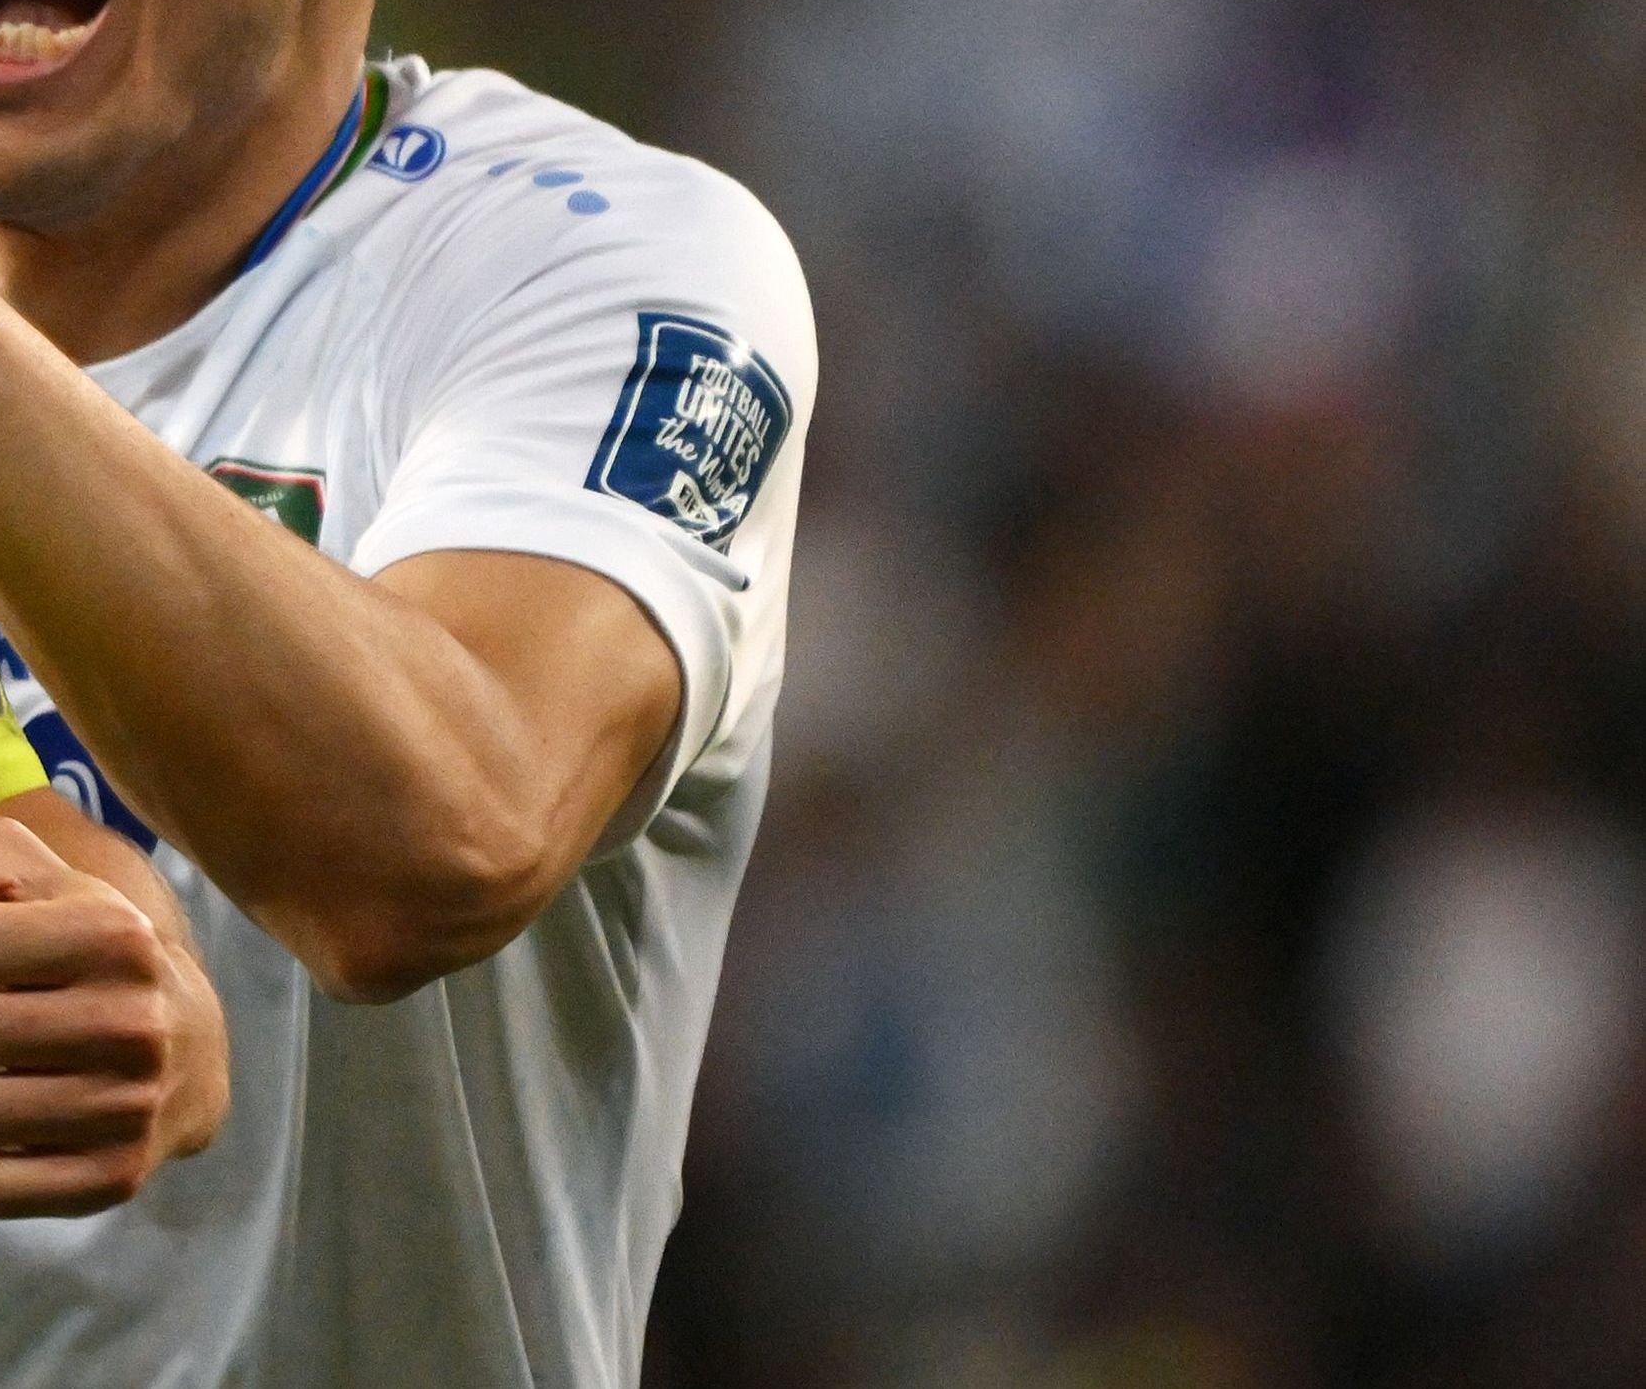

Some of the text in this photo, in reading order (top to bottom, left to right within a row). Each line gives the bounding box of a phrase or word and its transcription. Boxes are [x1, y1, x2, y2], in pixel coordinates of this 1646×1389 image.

[656, 417, 699, 461] the
[676, 377, 760, 486] UNITES
[689, 354, 772, 449] FOOTBALL
